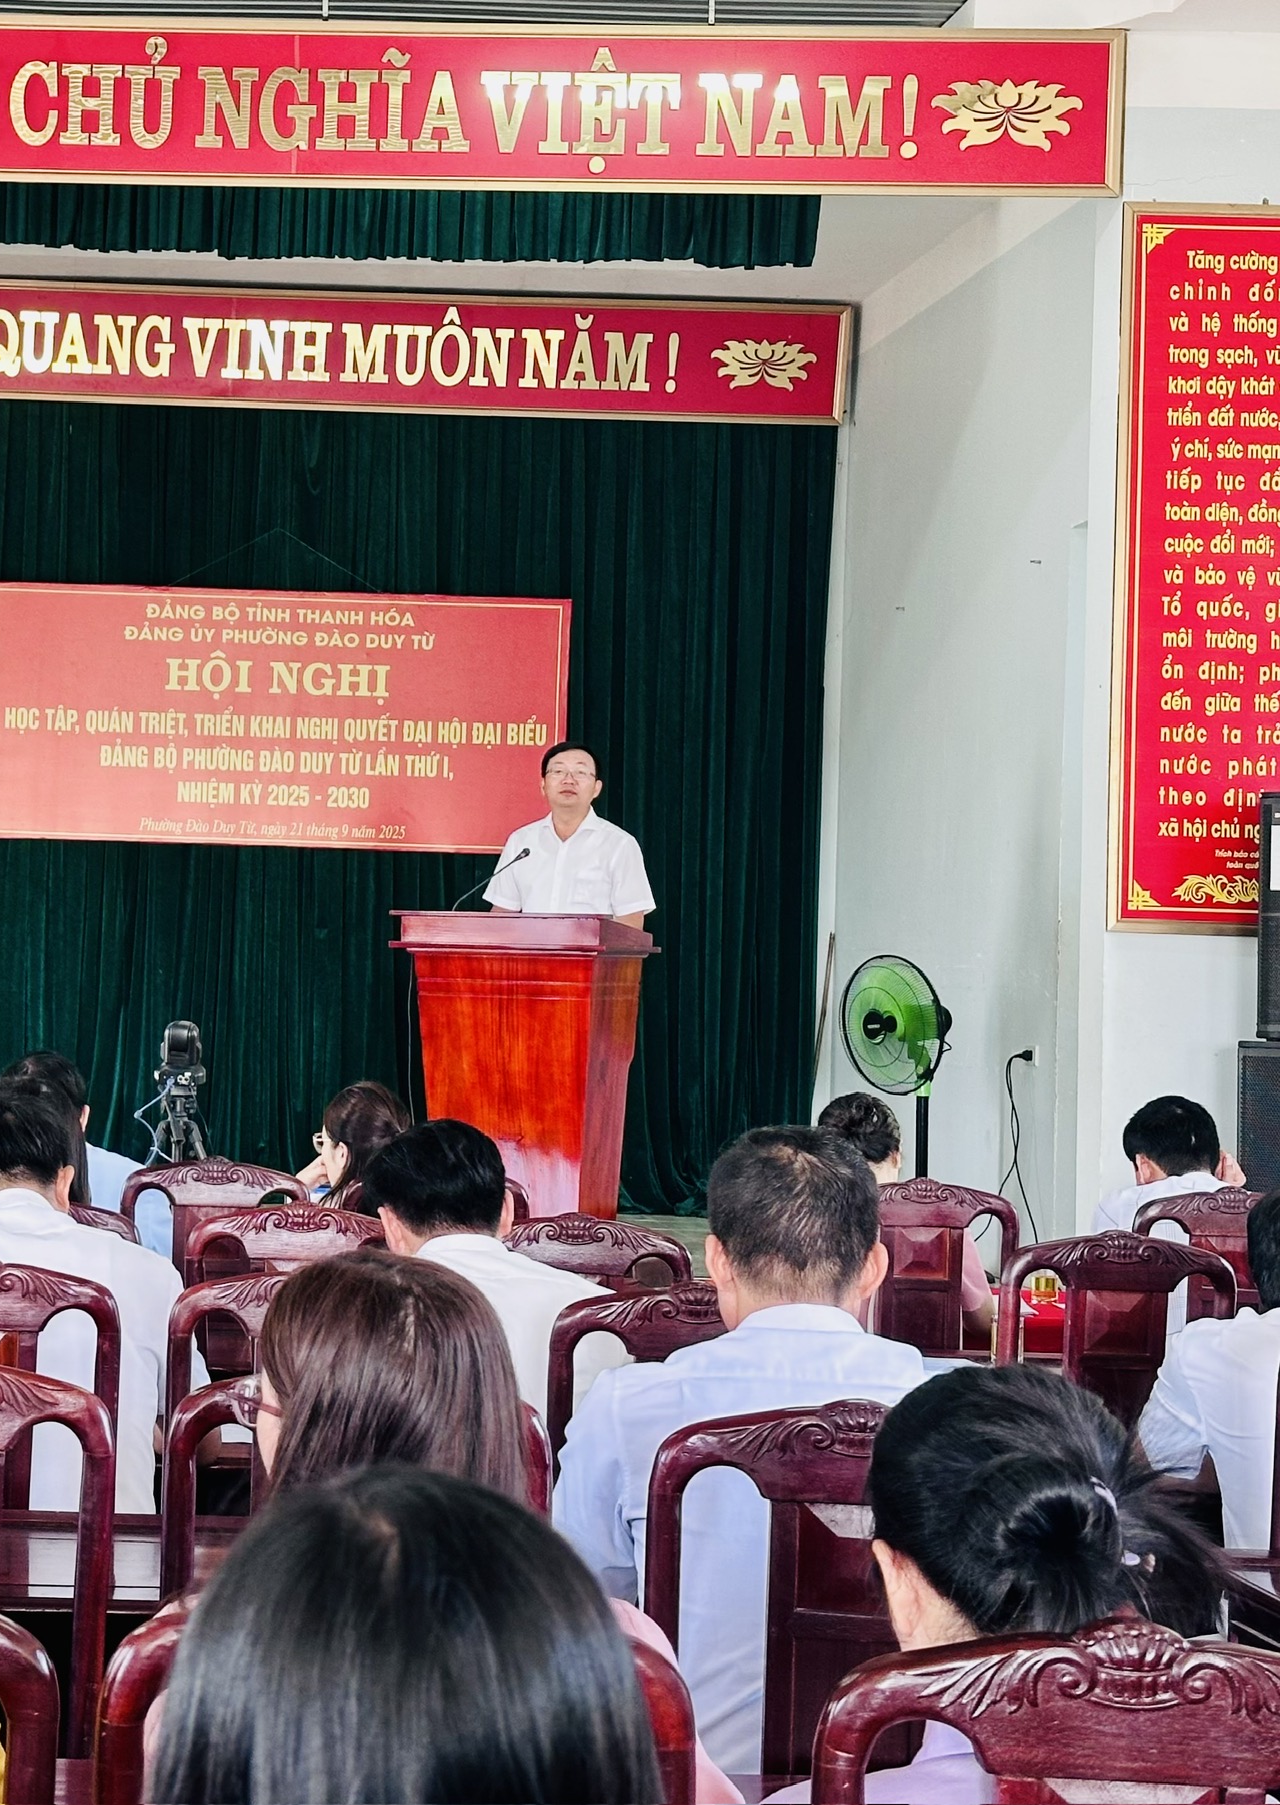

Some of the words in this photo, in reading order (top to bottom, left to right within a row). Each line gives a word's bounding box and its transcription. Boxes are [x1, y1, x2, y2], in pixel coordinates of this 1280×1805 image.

[9, 36, 180, 149] CHỦ
[195, 46, 470, 153] NGHĨA
[480, 46, 681, 174] VIỆT
[1186, 250, 1225, 274] Tăng
[1229, 250, 1278, 275] cường
[1170, 278, 1231, 302] chỉnh
[1248, 279, 1280, 302] đố
[1169, 311, 1189, 332] và
[1202, 312, 1221, 337] hệ
[1233, 310, 1277, 338] thống
[182, 316, 331, 382] VINH
[341, 305, 516, 389] MUÔN
[517, 313, 653, 393] NĂM
[1169, 344, 1209, 368] trong
[1216, 345, 1258, 368] sạch,
[1168, 376, 1201, 395] khơi
[1206, 375, 1236, 400] dậy
[1241, 375, 1275, 396] khát
[1167, 401, 1201, 427] triển
[1207, 404, 1234, 427] đất
[1171, 437, 1181, 461] ý
[1184, 436, 1212, 462] chí,
[1216, 437, 1244, 459] sức
[1166, 466, 1202, 493] tiếp
[1216, 470, 1245, 495] tục
[1165, 501, 1200, 522] toàn
[1205, 502, 1243, 526] diện,
[1164, 532, 1203, 558] cuộc
[1210, 529, 1235, 555] đổi
[1241, 533, 1275, 558] mới;
[1163, 564, 1184, 584] và
[1195, 563, 1226, 585] bảo
[1237, 565, 1256, 590] vệ
[146, 599, 206, 620] ĐẢNG
[212, 602, 240, 625] BỘ
[246, 602, 290, 622] TỈNH
[297, 609, 364, 625] THANH
[371, 607, 415, 627] HÓA
[1161, 590, 1182, 616] Tổ
[1196, 593, 1250, 621] quốc,
[124, 622, 184, 641] ĐẢNG
[191, 623, 216, 642] ỦY
[222, 626, 308, 646] PHƯỜNG
[315, 631, 360, 648] ĐÀO
[366, 633, 406, 650] DUY
[411, 631, 435, 651] TỪ
[1162, 627, 1193, 648] môi
[1205, 627, 1257, 654] trường
[165, 649, 253, 700] HỘI
[269, 661, 391, 705] NGHỊ
[1161, 653, 1183, 679] ổn
[1198, 661, 1244, 685] định;
[1160, 688, 1192, 711] đến
[1205, 692, 1241, 716] giữa
[4, 706, 40, 734] HỌC
[45, 704, 81, 735] TẬP,
[85, 706, 134, 735] QUÁN
[139, 708, 189, 739] TRIỆT,
[194, 706, 245, 737] TRIỂN
[249, 715, 291, 739] KHAI
[296, 716, 338, 745] NGHỊ
[344, 712, 398, 743] QUYẾT
[402, 719, 432, 747] ĐẠI
[438, 717, 467, 749] HỘI
[472, 721, 501, 749] ĐẠI
[506, 714, 547, 746] BIỂU
[1160, 721, 1208, 743] nước
[1222, 724, 1241, 743] ta
[100, 738, 148, 768] ĐẢNG
[154, 742, 177, 774] BỘ
[182, 744, 254, 772] PHƯỜNG
[259, 746, 295, 773] ĐÀO
[299, 751, 335, 775] DUY
[339, 748, 363, 775] TỪ
[365, 747, 400, 777] LẦN
[405, 750, 440, 778] THỨ
[442, 755, 454, 781] I,
[1160, 754, 1211, 775] nước
[1228, 754, 1278, 780] phát
[176, 778, 235, 808] NHIỆM
[240, 779, 263, 805] KỲ
[267, 784, 310, 807] 2025
[327, 786, 370, 809] 2030
[1159, 786, 1207, 806] theo
[1223, 788, 1264, 812] địn
[139, 817, 183, 835] Phường
[186, 818, 209, 833] Đào
[213, 819, 236, 836] Duy
[240, 820, 257, 836] Từ,
[261, 822, 287, 838] ngày
[289, 822, 303, 836] 21
[307, 823, 338, 839] tháng
[342, 824, 349, 837] 9
[352, 825, 375, 838] năm
[379, 825, 406, 839] 2025
[1158, 817, 1179, 837] xã
[1183, 817, 1207, 842] hội
[1211, 817, 1240, 838] chủ
